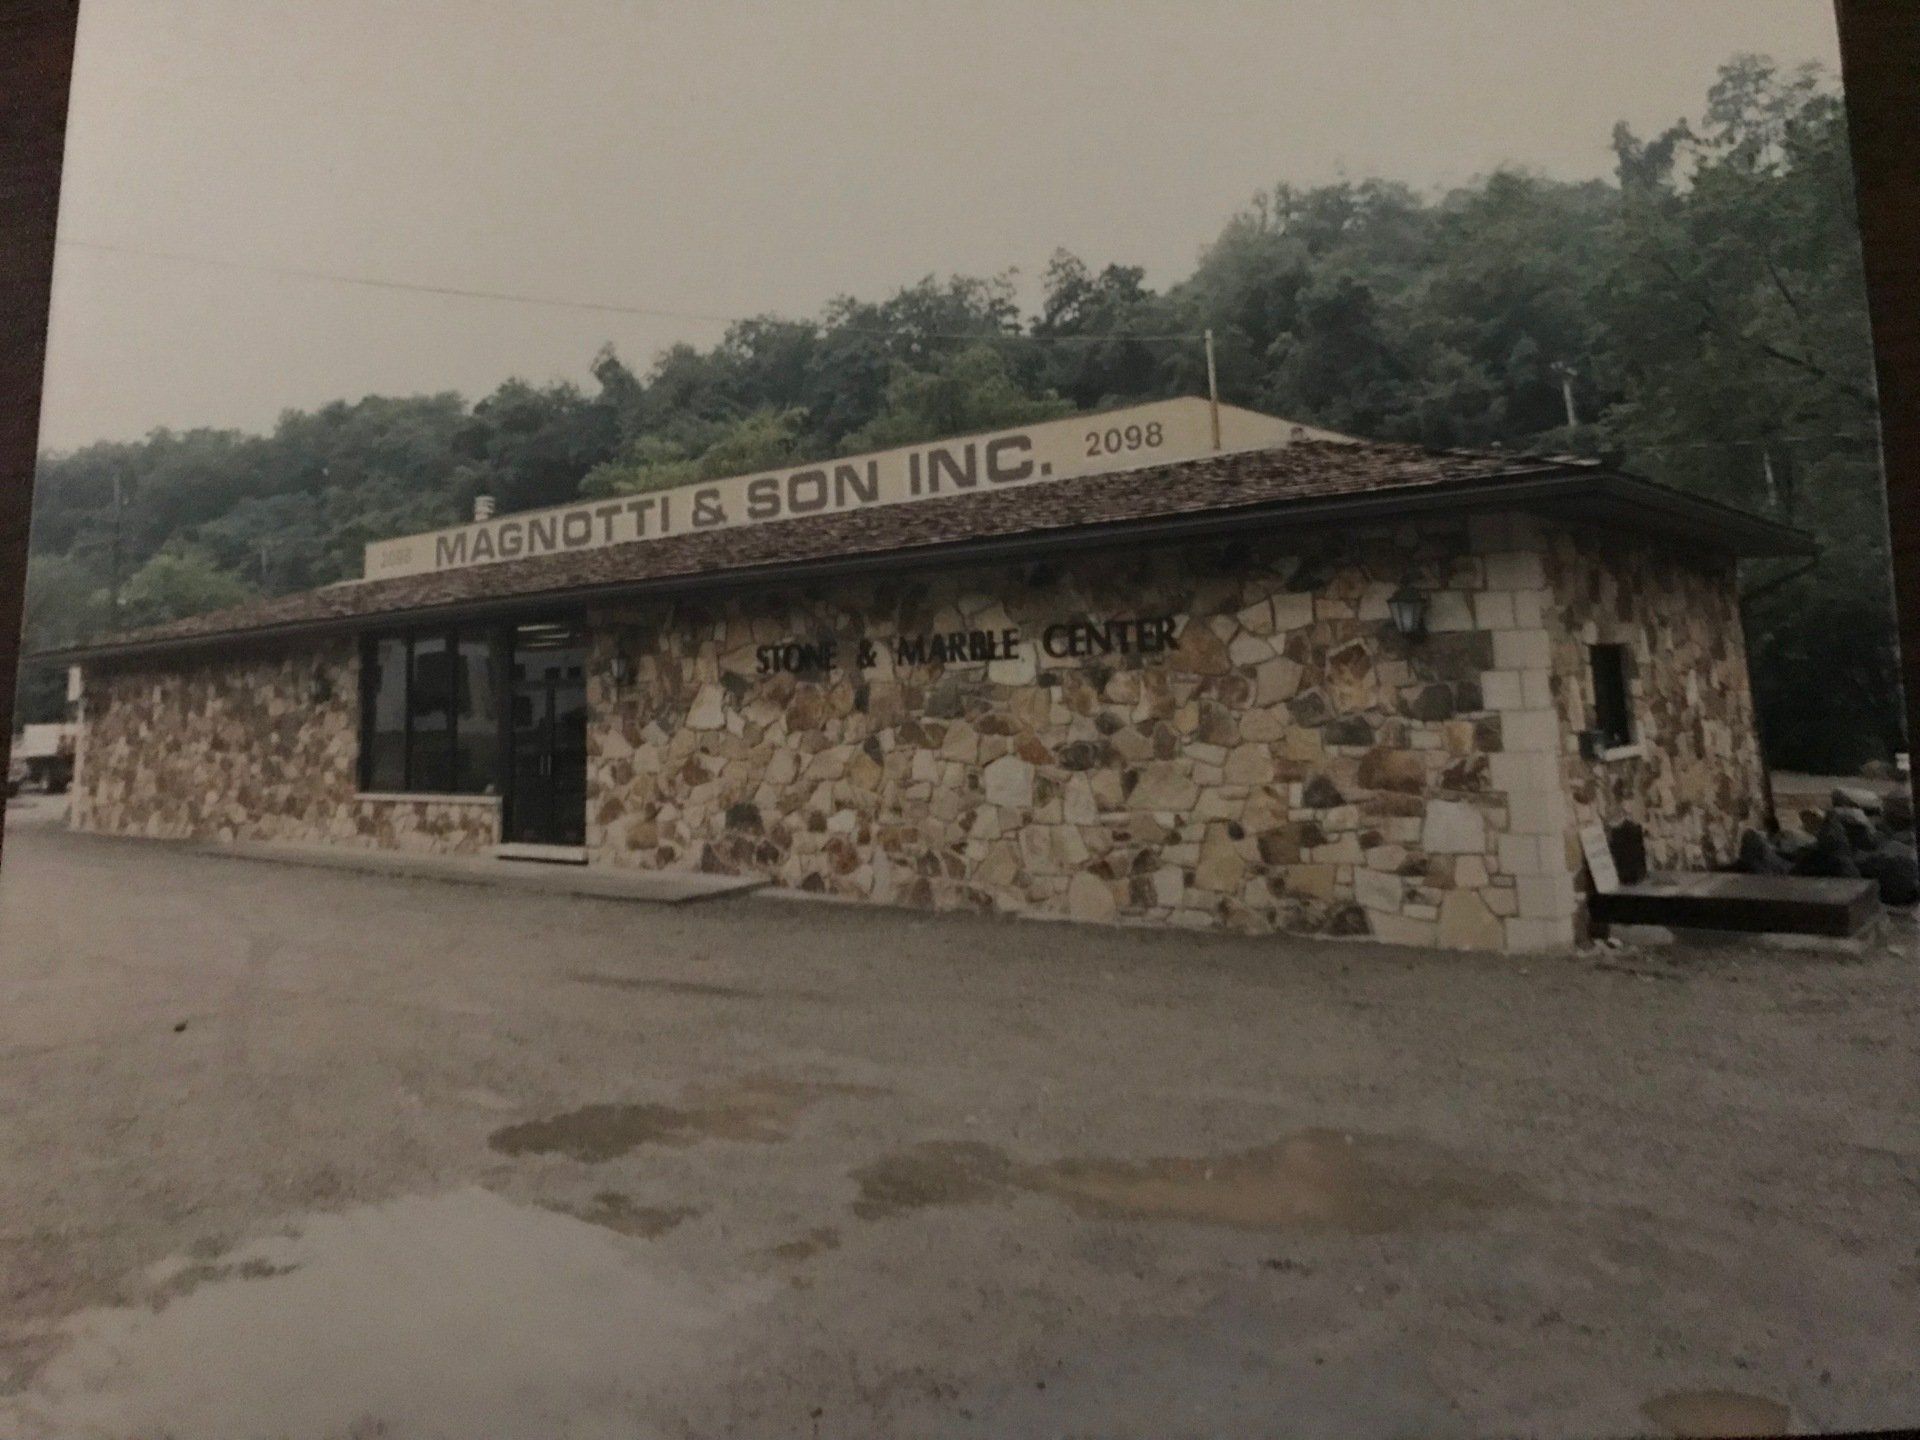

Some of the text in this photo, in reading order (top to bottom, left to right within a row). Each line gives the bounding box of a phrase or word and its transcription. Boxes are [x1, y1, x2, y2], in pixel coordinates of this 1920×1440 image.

[436, 497, 670, 568] MAGNOTTI
[692, 489, 727, 527] &
[747, 460, 879, 519] SON
[909, 435, 1052, 494] INC.
[1085, 422, 1164, 457] 2098
[757, 616, 1181, 674] STONE & MARBLE CENTER
